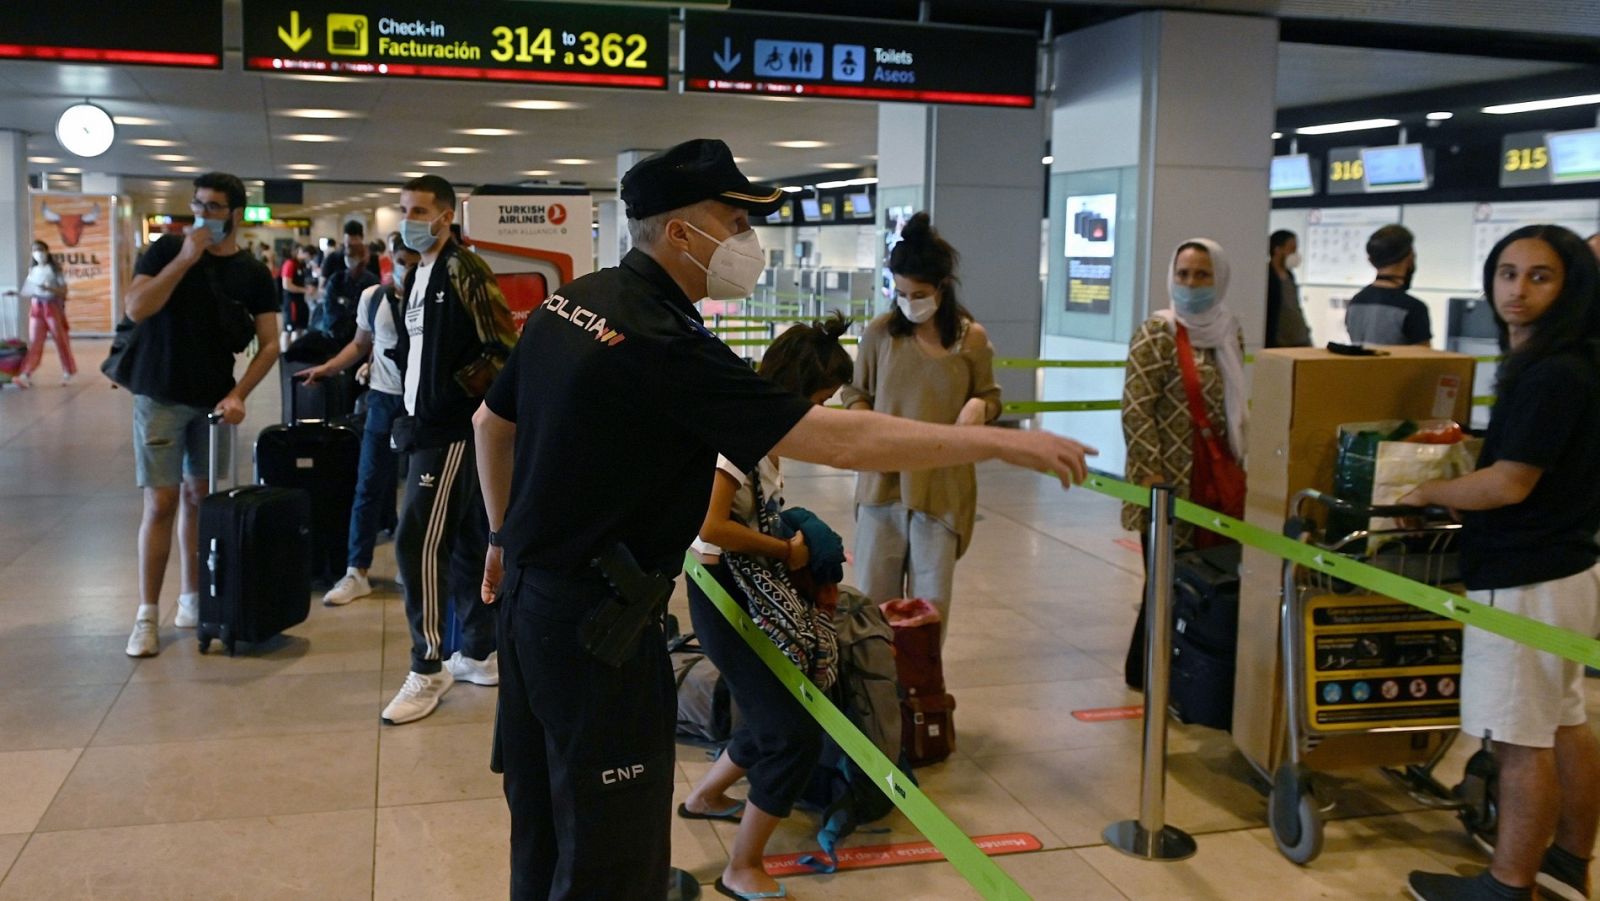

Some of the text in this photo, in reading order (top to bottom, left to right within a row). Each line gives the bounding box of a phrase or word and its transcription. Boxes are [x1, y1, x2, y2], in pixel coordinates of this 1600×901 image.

[378, 17, 445, 38] Check-in
[378, 36, 481, 61] Facturación
[490, 26, 648, 69] 314 to 362
[873, 47, 914, 65] Toilets
[564, 52, 575, 65] a
[873, 65, 916, 83] Aseos
[1503, 147, 1548, 171] 315
[1329, 160, 1364, 181] 316
[498, 205, 545, 214] TURKISH
[498, 215, 546, 225] AIRLINES
[602, 764, 644, 785] CNP
